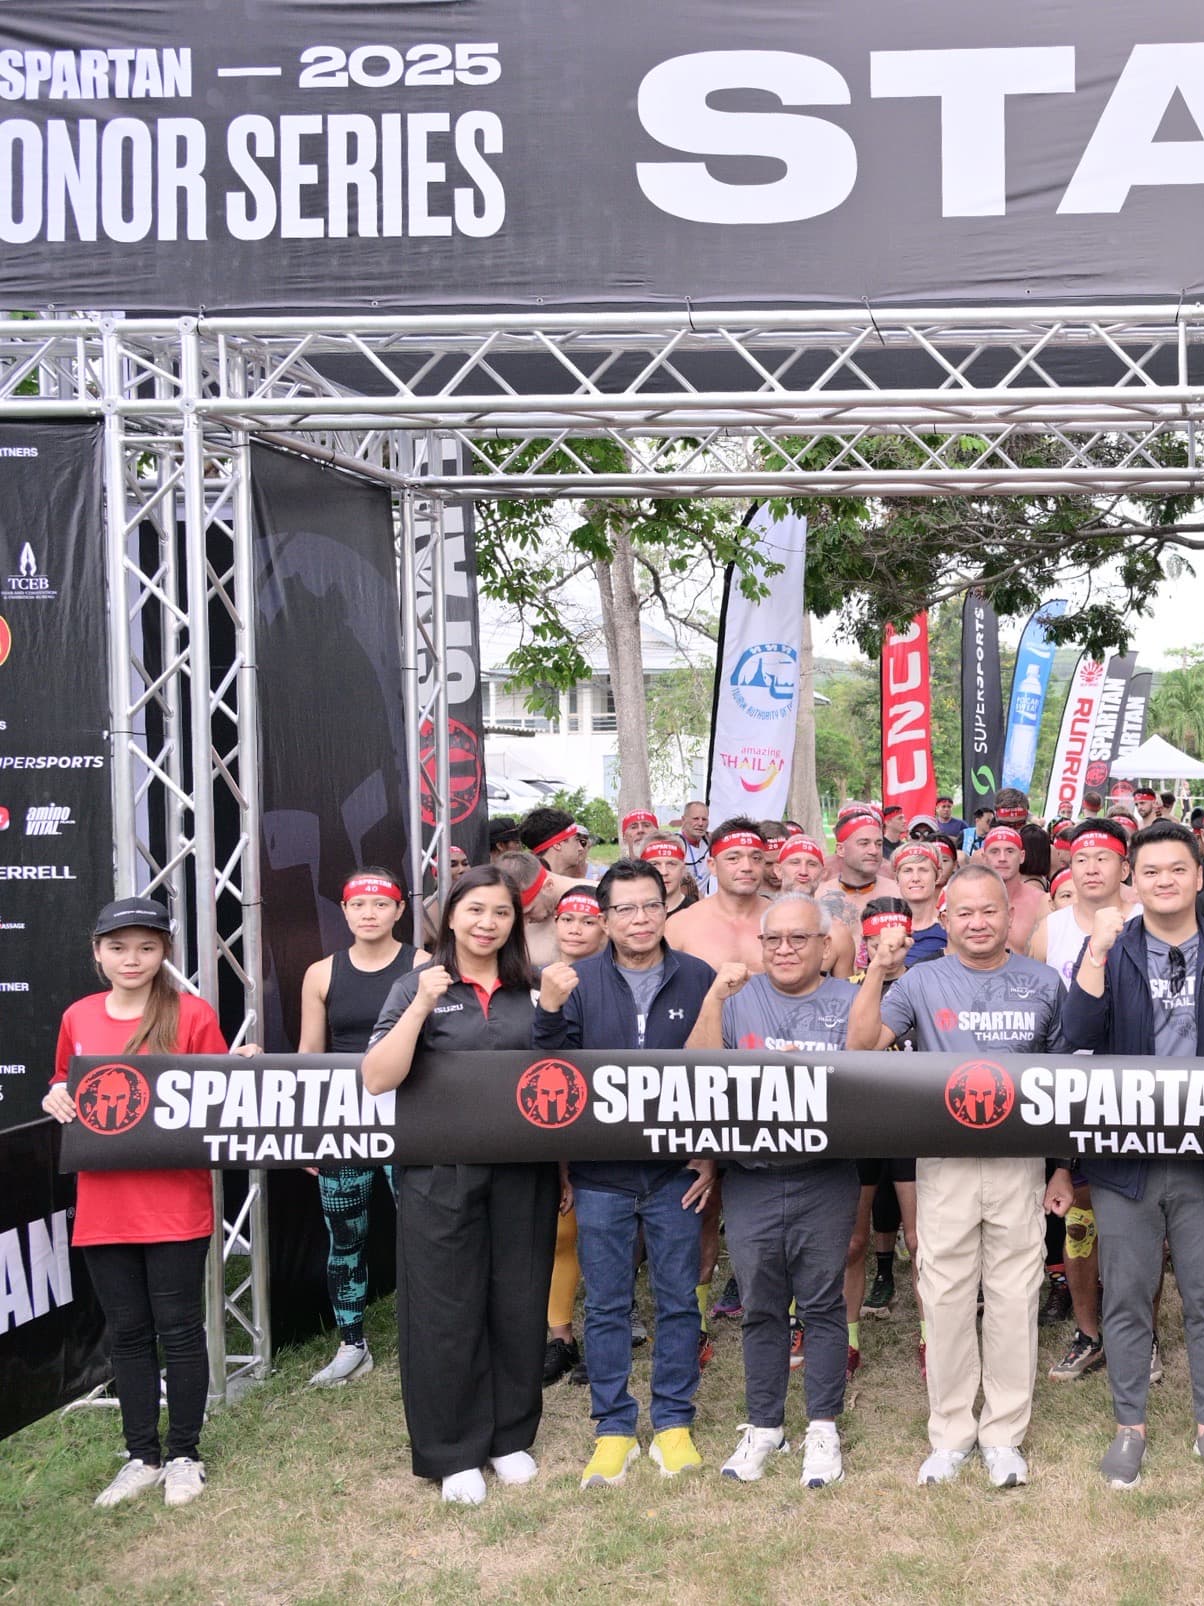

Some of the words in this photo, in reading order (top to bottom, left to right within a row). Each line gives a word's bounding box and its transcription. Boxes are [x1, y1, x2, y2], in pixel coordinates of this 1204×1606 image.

[0, 48, 192, 100] SPARTAN
[299, 43, 502, 88] 2025
[225, 110, 506, 238] SERIES
[0, 447, 39, 457] TNERS
[8, 577, 49, 590] TCEB
[974, 606, 988, 755] SUPERSPORTS
[1090, 677, 1127, 762] SPARTAN
[741, 746, 782, 758] amazing
[1058, 697, 1094, 802] RUNRIO
[26, 802, 71, 821] amino
[25, 820, 63, 836] VITAL
[357, 878, 393, 889] SPARTAN
[0, 982, 29, 992] TNER
[434, 1004, 464, 1014] ISUZU
[958, 1010, 1036, 1031] SPARTAN
[974, 1031, 1035, 1041] THAILAND
[592, 1065, 828, 1124] SPARTAN
[203, 1132, 396, 1162] THAILAND
[643, 1127, 829, 1153] THAILAND
